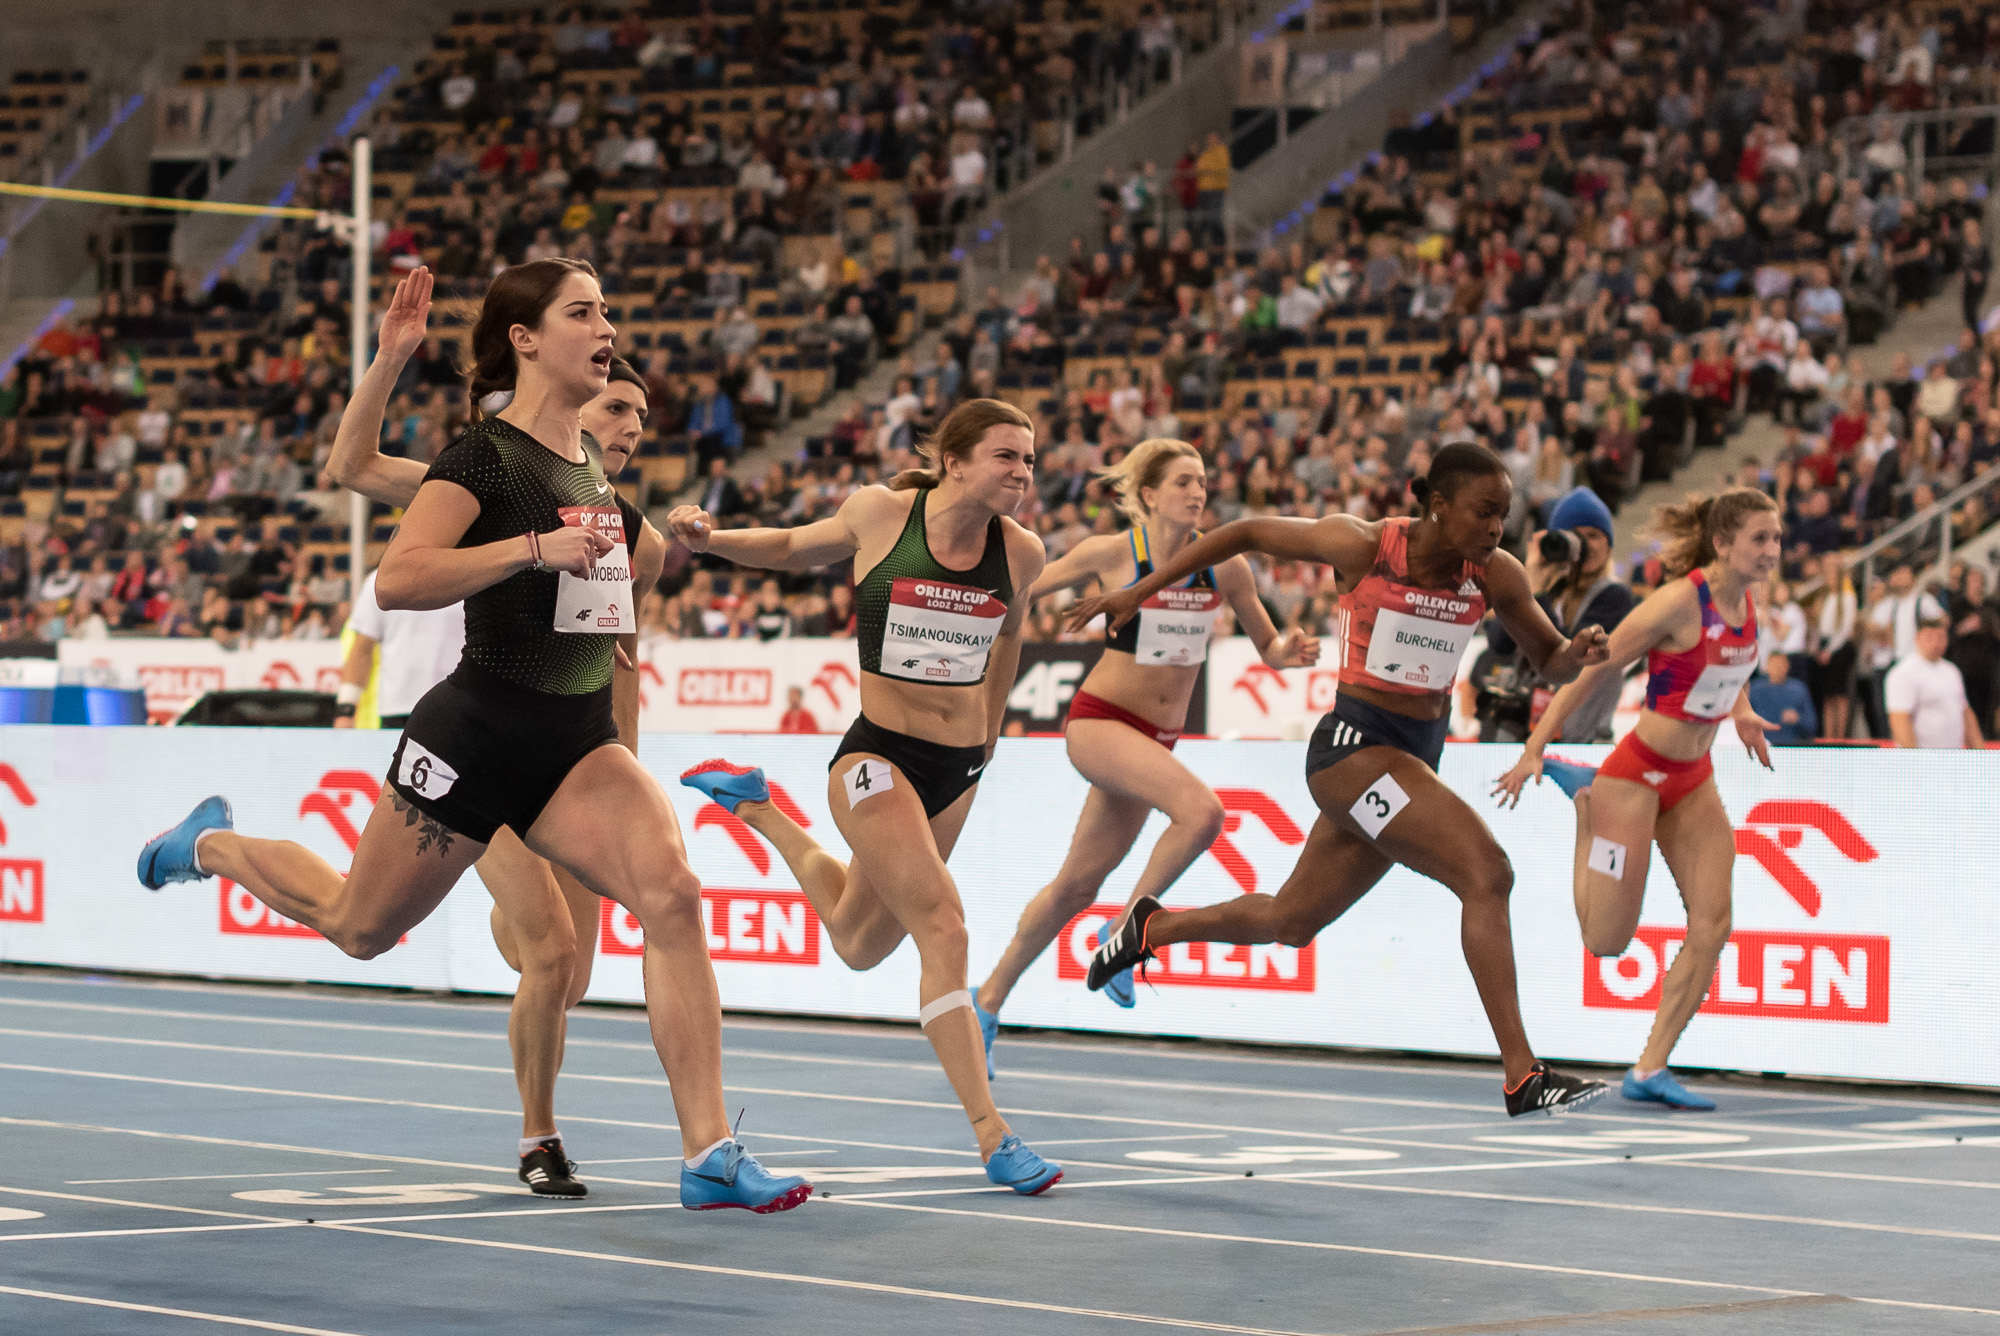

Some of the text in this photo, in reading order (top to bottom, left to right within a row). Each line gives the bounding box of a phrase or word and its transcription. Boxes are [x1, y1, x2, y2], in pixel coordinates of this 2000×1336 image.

[586, 566, 629, 581] WOBODA
[915, 584, 989, 605] ORLEN CUP
[927, 599, 973, 613] ŁÓDŹ 2019
[1405, 591, 1470, 614] ORLEN CUP
[576, 609, 592, 621] 4F
[890, 622, 993, 647] TSIMANOUSKAYA
[1395, 631, 1455, 653] BURCHELL
[902, 659, 920, 669] 4F
[1009, 661, 1083, 718] 4F
[855, 763, 872, 791] 4
[1366, 791, 1390, 818] 3
[611, 898, 806, 955] OLEN
[1600, 937, 1868, 1009] OLEN
[1124, 1145, 1400, 1164] 3
[231, 1182, 532, 1206] 5
